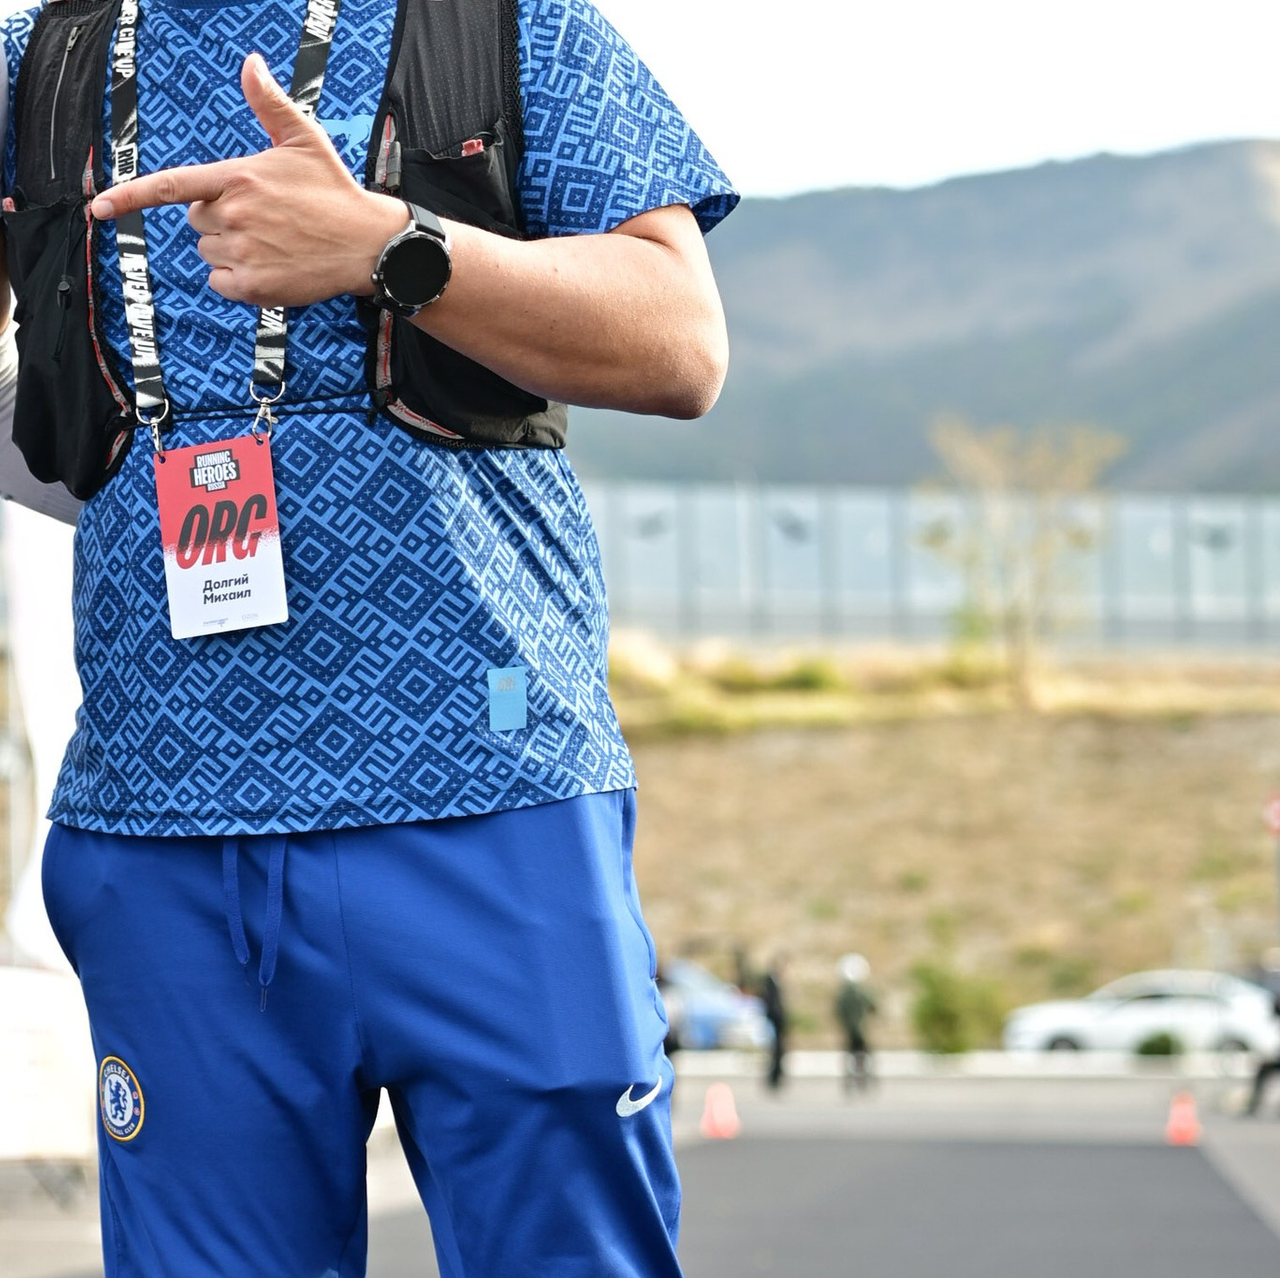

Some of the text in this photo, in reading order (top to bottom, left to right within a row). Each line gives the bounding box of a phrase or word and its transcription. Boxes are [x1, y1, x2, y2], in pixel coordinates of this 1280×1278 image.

[196, 451, 231, 468] RUNNING
[193, 462, 237, 486] HEROES
[176, 493, 268, 570] ORG
[203, 573, 249, 594] Долгий
[203, 589, 252, 605] Михаил
[104, 1064, 130, 1083] CHELSEA
